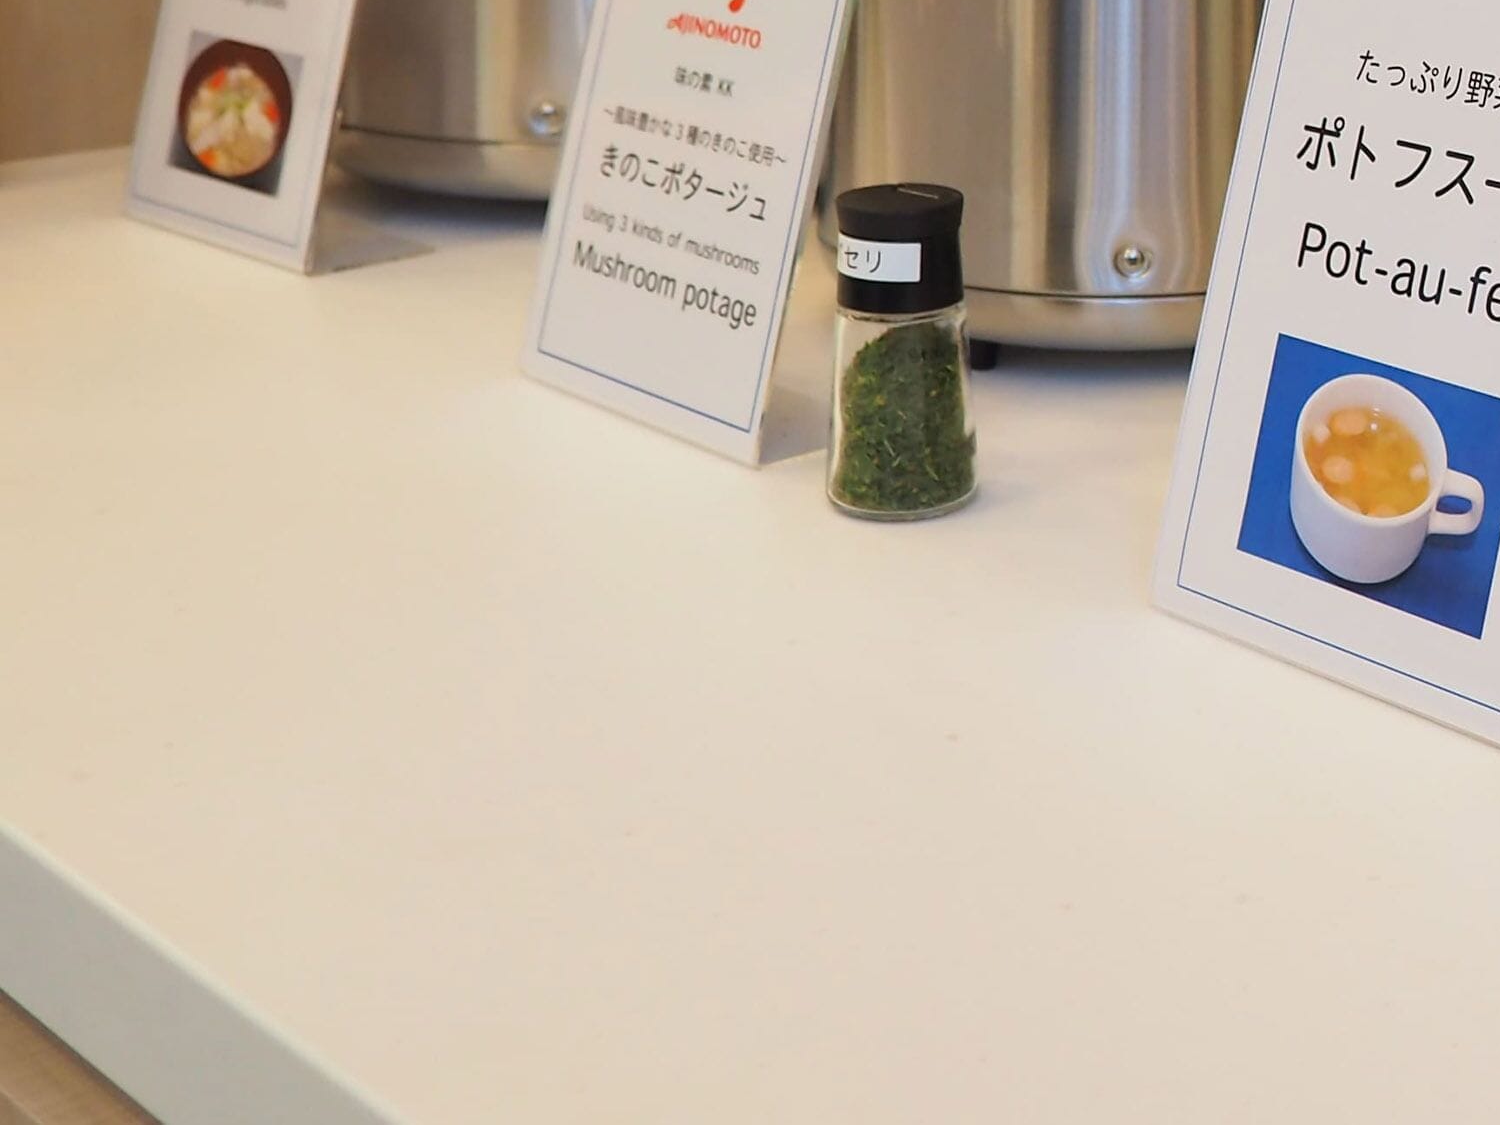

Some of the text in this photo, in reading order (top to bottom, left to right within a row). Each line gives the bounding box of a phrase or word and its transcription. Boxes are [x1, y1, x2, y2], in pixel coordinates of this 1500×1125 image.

[667, 13, 762, 50] AJINOMOTO
[600, 144, 767, 221] きのこポタージュ
[582, 202, 760, 275] Using 3 kinds of mushrooms
[839, 242, 881, 273] セリ
[572, 239, 757, 330] Mushroom potage
